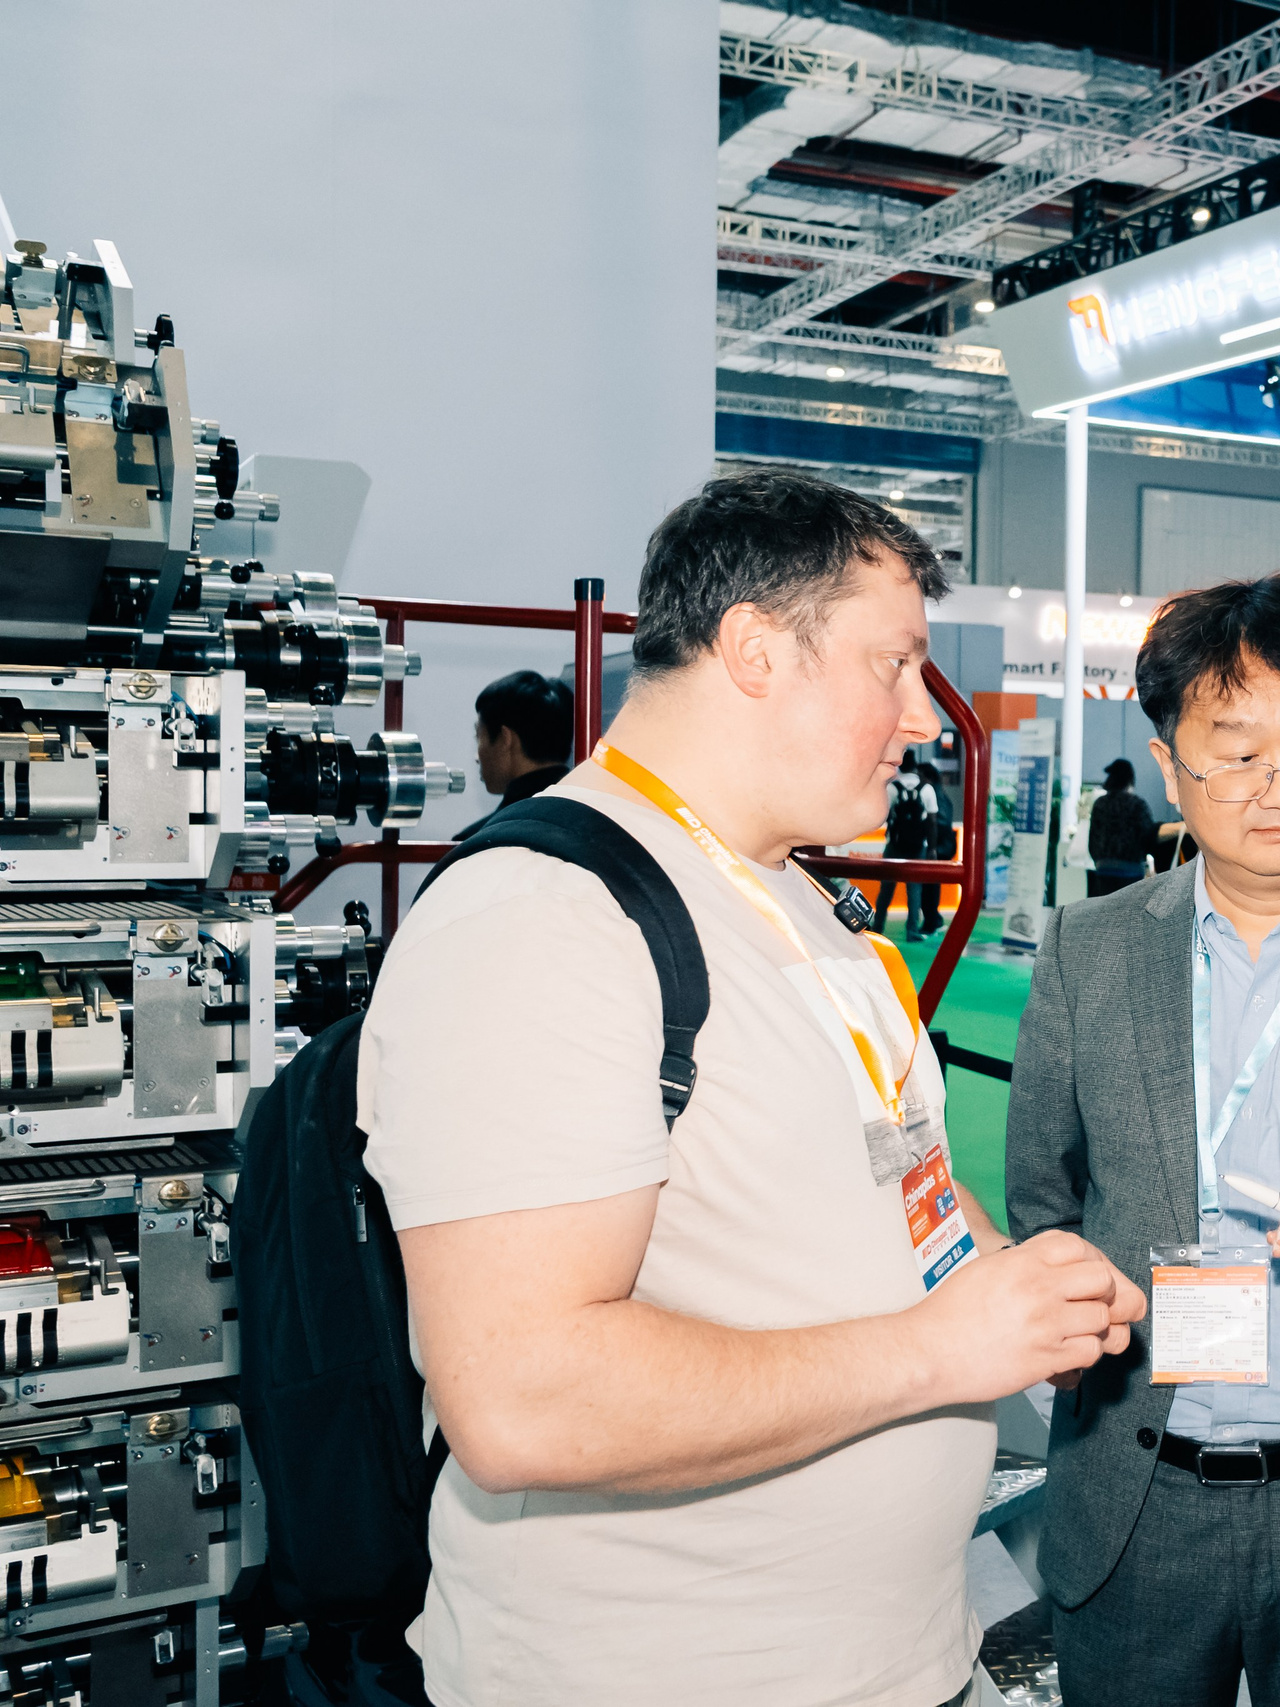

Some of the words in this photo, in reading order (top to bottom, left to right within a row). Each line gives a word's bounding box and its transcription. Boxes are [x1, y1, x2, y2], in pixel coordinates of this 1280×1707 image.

[1003, 662, 1044, 674] mart
[1052, 662, 1117, 680] Ftory
[905, 1174, 936, 1210] Chinaplas
[933, 1254, 954, 1279] VISITOR
